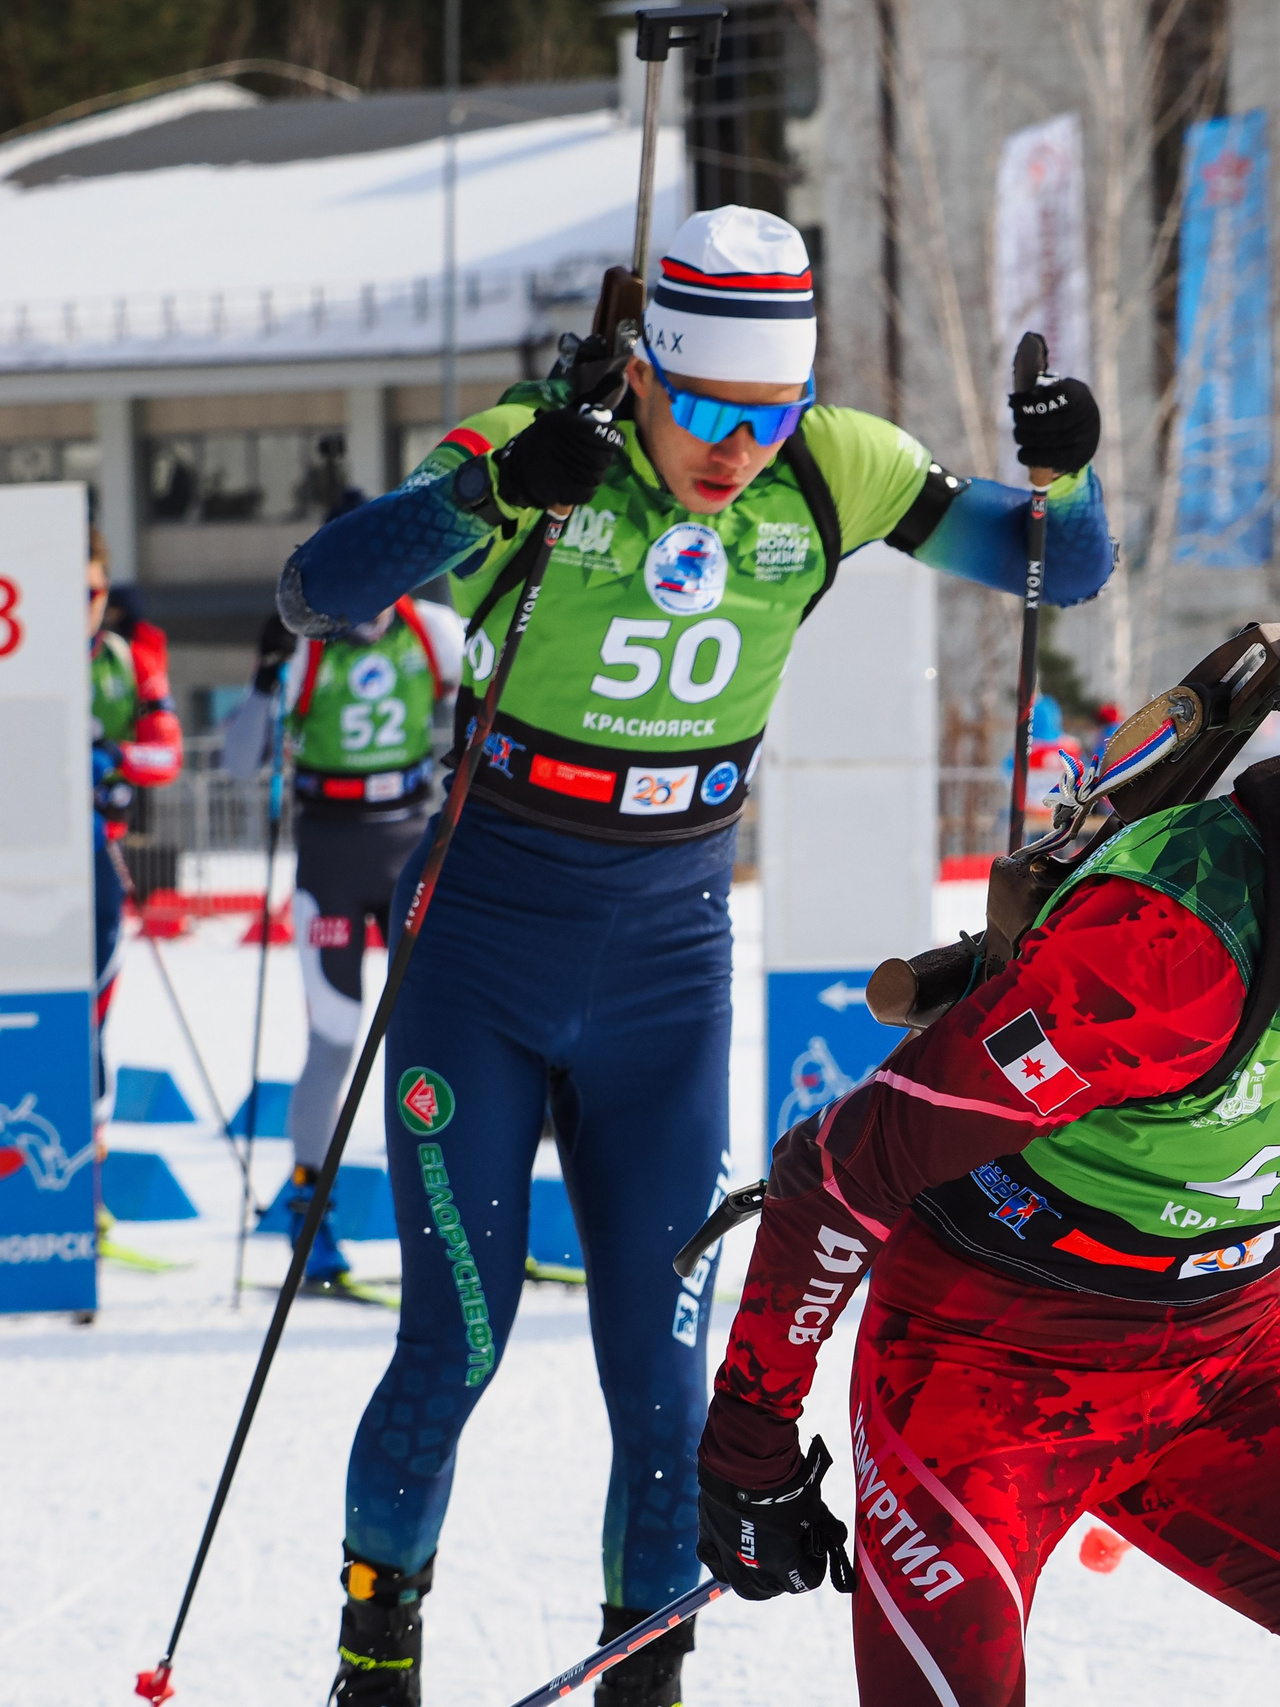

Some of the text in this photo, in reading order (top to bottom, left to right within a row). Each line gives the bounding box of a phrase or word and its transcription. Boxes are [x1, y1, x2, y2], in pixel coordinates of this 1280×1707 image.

[1021, 394, 1069, 416] MOAX
[515, 585, 542, 633] MOAX
[1026, 559, 1041, 610] MOAX
[590, 616, 742, 704] 50
[340, 697, 407, 751] 52
[583, 711, 717, 737] КРАСНОЯРСК
[417, 1142, 496, 1388] БЕЛОРУСНЕФТЬ
[787, 1280, 844, 1345] ПСБ
[852, 1400, 965, 1602] УДМУРТИЯ
